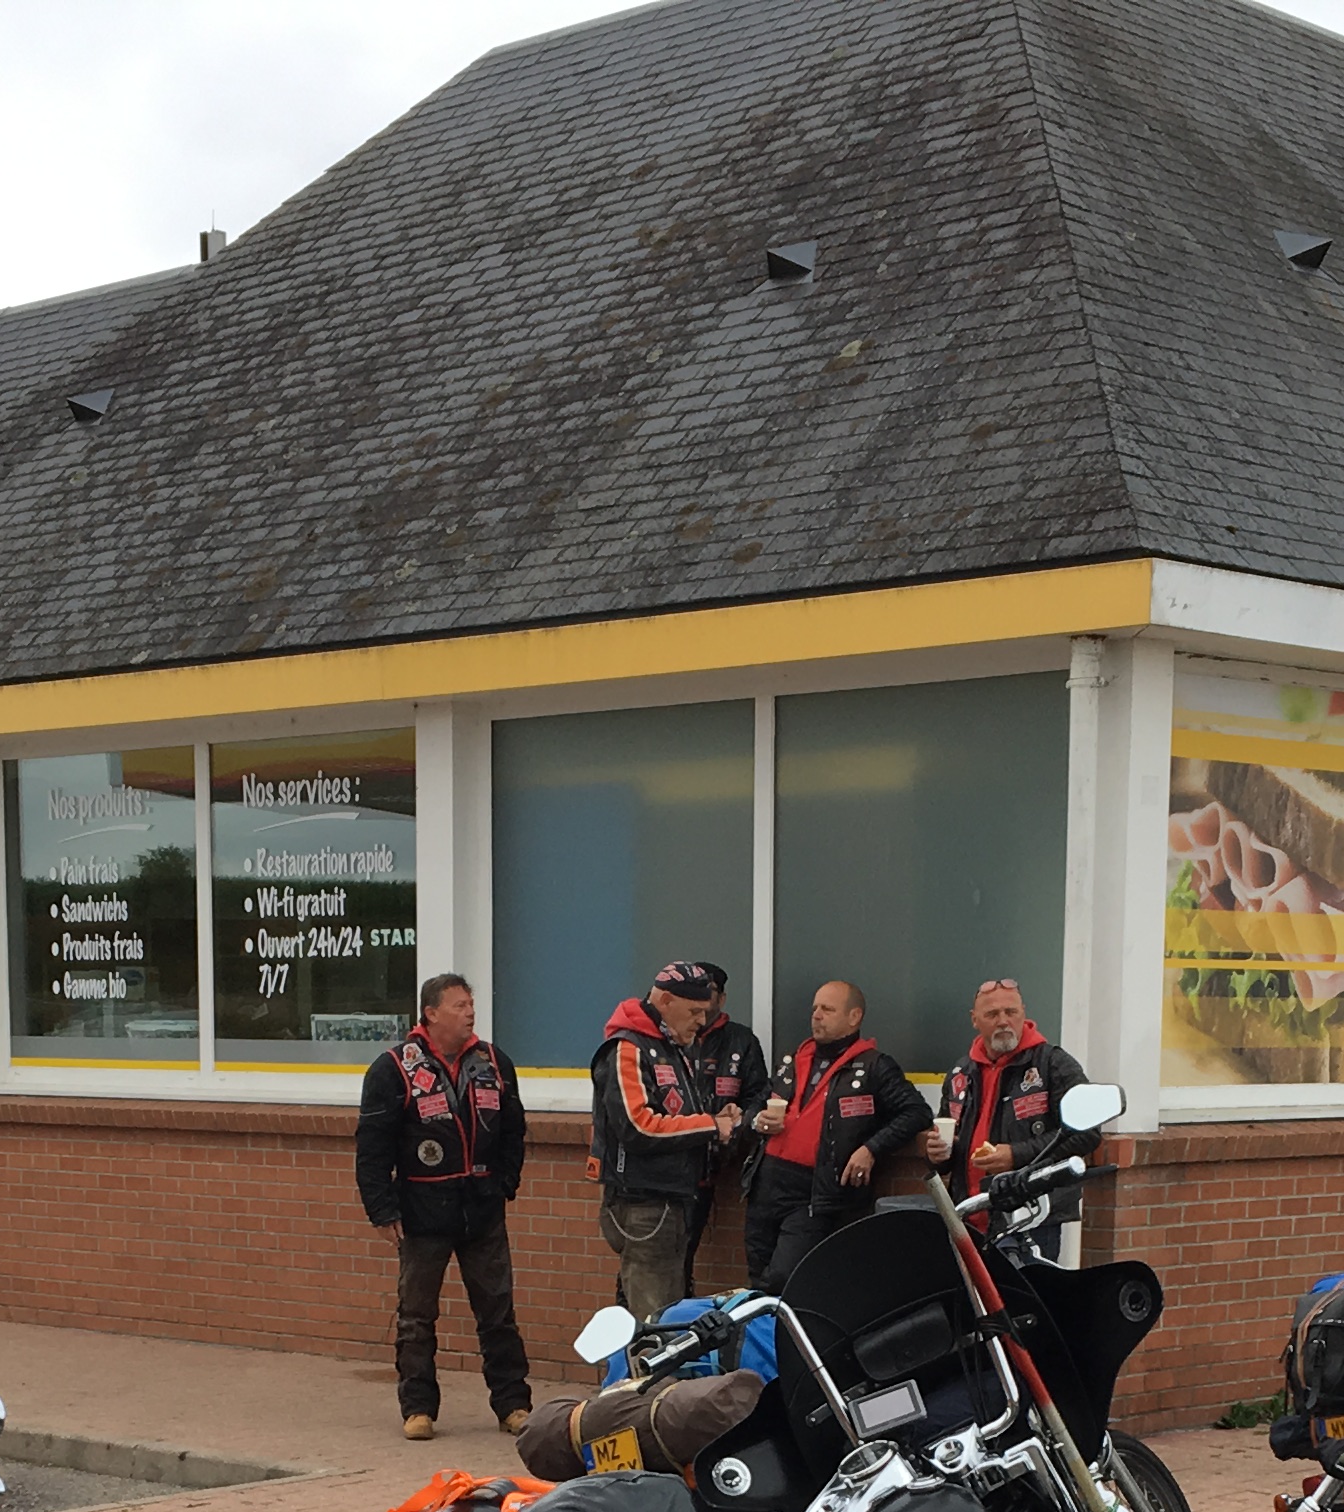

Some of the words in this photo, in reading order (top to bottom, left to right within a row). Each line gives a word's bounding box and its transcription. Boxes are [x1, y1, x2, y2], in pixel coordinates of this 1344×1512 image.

[47, 787, 76, 820] Nos
[78, 784, 143, 825] produits
[242, 772, 274, 808] Nos
[277, 770, 351, 807] services
[61, 856, 87, 885] Pain
[89, 855, 118, 884] frais
[257, 846, 348, 877] Restauration
[350, 844, 393, 880] rapide
[62, 892, 128, 922] Sandwichs
[257, 886, 294, 918] Wi-fi
[297, 886, 346, 922] gratuit
[63, 931, 111, 961] Produits
[113, 930, 144, 960] frais
[258, 928, 305, 958] Ouvert
[307, 925, 363, 958] 24h/24
[370, 928, 416, 947] STAR
[64, 971, 107, 1000] Gamme
[109, 971, 127, 999] bio
[258, 963, 289, 998] 7j/7
[596, 1439, 621, 1465] MZ
